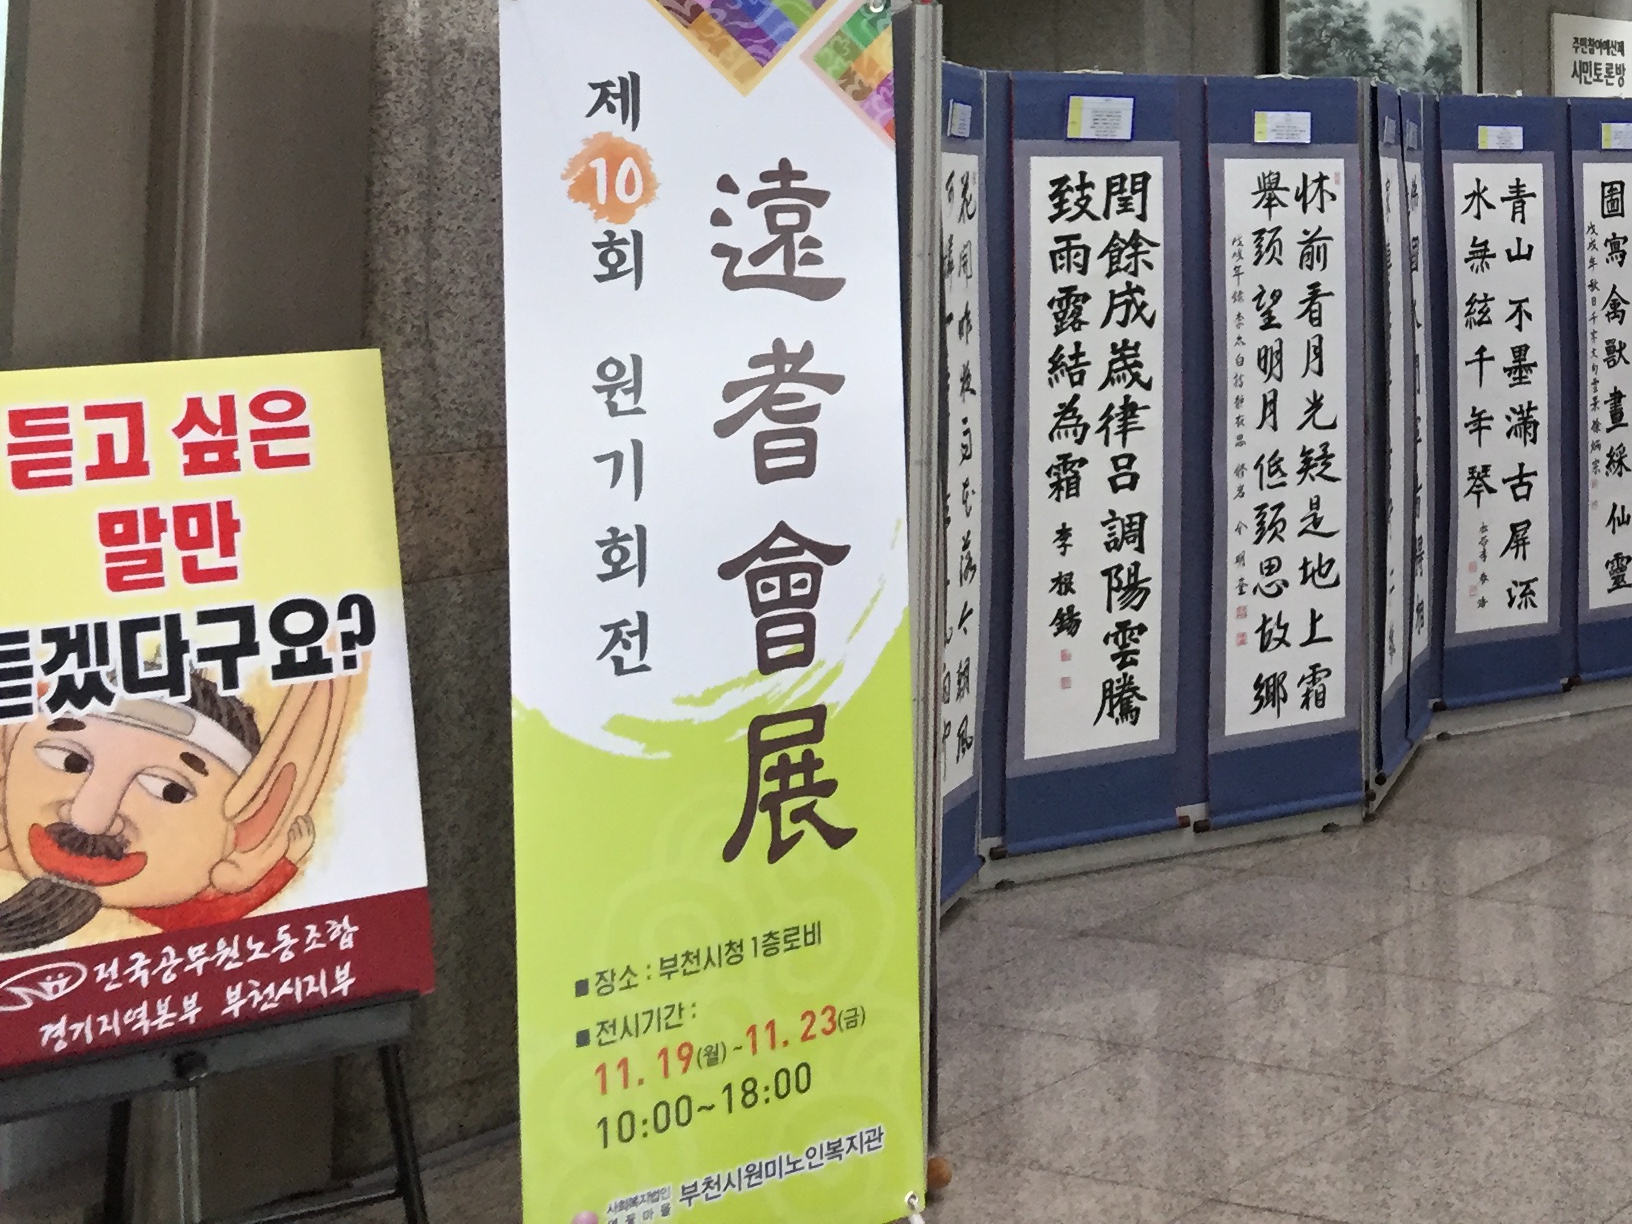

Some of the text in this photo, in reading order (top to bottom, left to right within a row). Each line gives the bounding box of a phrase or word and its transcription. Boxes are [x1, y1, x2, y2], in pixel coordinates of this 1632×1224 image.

[1570, 59, 1627, 88] 시민토론방
[7, 389, 312, 490] 듣고 싶은
[97, 500, 241, 593] 말만
[591, 353, 652, 677] 원기회전
[94, 914, 360, 994] 전국공무원노동조합
[594, 965, 639, 998] 장소
[658, 939, 746, 981] 부천시청
[752, 920, 823, 959] 1층로비
[38, 961, 357, 1054] 경기지역본부 부천시지부
[595, 1002, 685, 1047] 전시기간
[596, 1061, 813, 1150] 10:00~18:00
[678, 1125, 885, 1208] 부천시원미노인복지관
